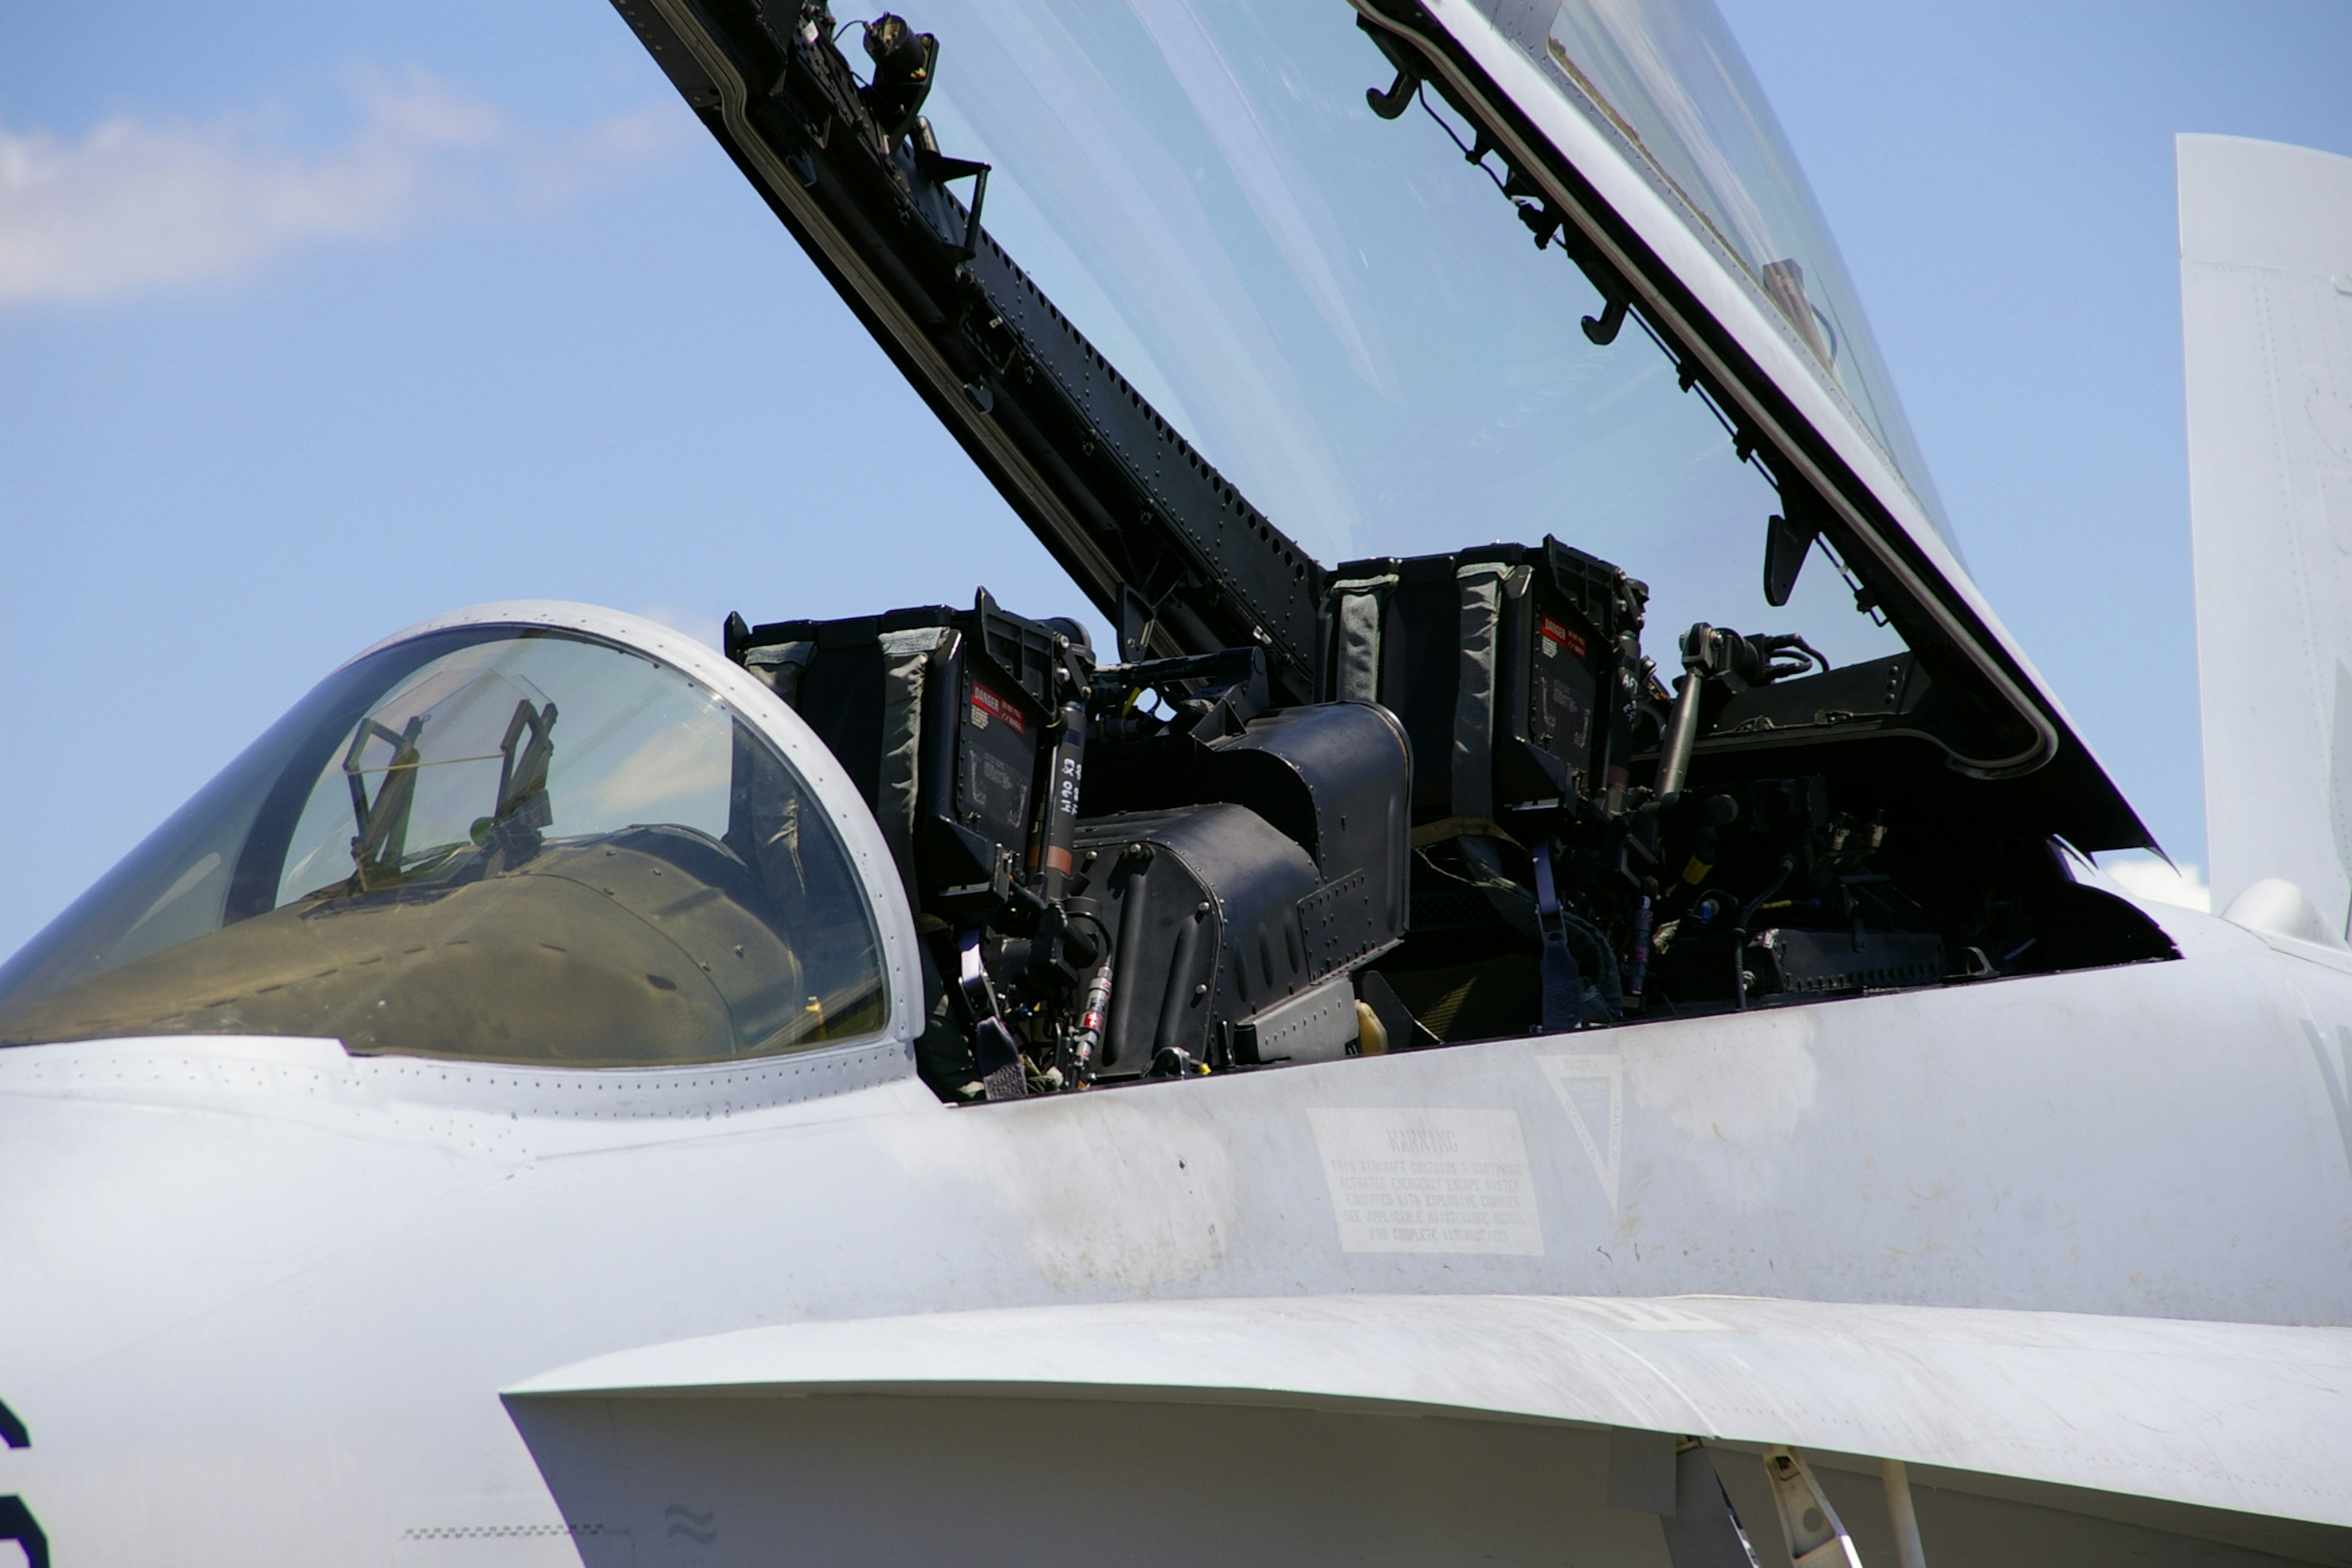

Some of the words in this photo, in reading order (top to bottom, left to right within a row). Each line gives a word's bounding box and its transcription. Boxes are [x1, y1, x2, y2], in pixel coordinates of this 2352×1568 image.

[1545, 617, 1566, 641] DANGER
[974, 686, 1000, 712] DANGER
[1061, 758, 1075, 777] EX
[1387, 1129, 1459, 1153] WARNING
[1331, 1159, 1355, 1174] THIS
[1361, 1160, 1405, 1175] AIRCRAFT
[1411, 1161, 1457, 1175] CONTAINS
[1462, 1163, 1469, 1175] A
[1472, 1163, 1523, 1175] CARTRIDGE
[1340, 1177, 1387, 1190] ACTUATED
[1446, 1178, 1482, 1191] ESCAPE
[1485, 1179, 1520, 1192] SYSTEM
[1347, 1193, 1393, 1207] EQUIPPED
[1398, 1194, 1421, 1207] WITH
[1426, 1194, 1477, 1208] EXPLOSIVE
[1481, 1195, 1520, 1208] CHARGES
[1343, 1210, 1360, 1223] SEE
[1368, 1210, 1422, 1224] APPLICABLE
[1428, 1211, 1490, 1225] MAINTENANCE
[1370, 1227, 1388, 1241] FOR
[1393, 1228, 1437, 1242] COMPLETE
[1443, 1229, 1509, 1243] INSTRUCTIONS
